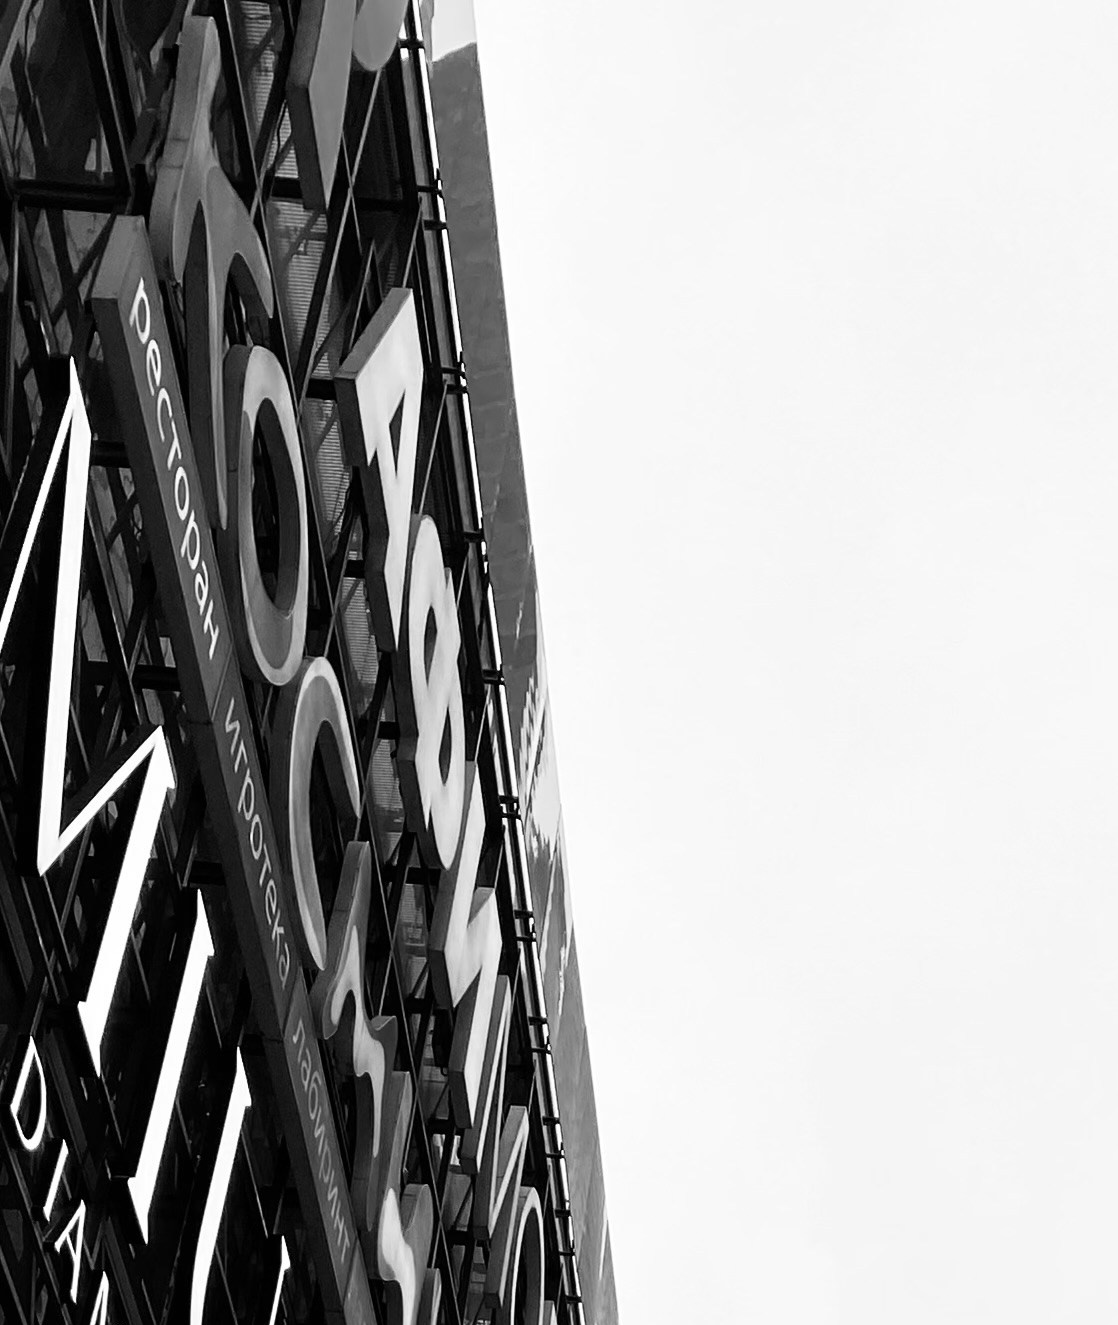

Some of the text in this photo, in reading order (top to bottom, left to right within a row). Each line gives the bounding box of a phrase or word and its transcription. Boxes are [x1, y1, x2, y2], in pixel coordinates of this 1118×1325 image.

[130, 277, 220, 660] ресторан
[225, 697, 290, 990] игротека
[292, 1019, 350, 1265] лабиринт
